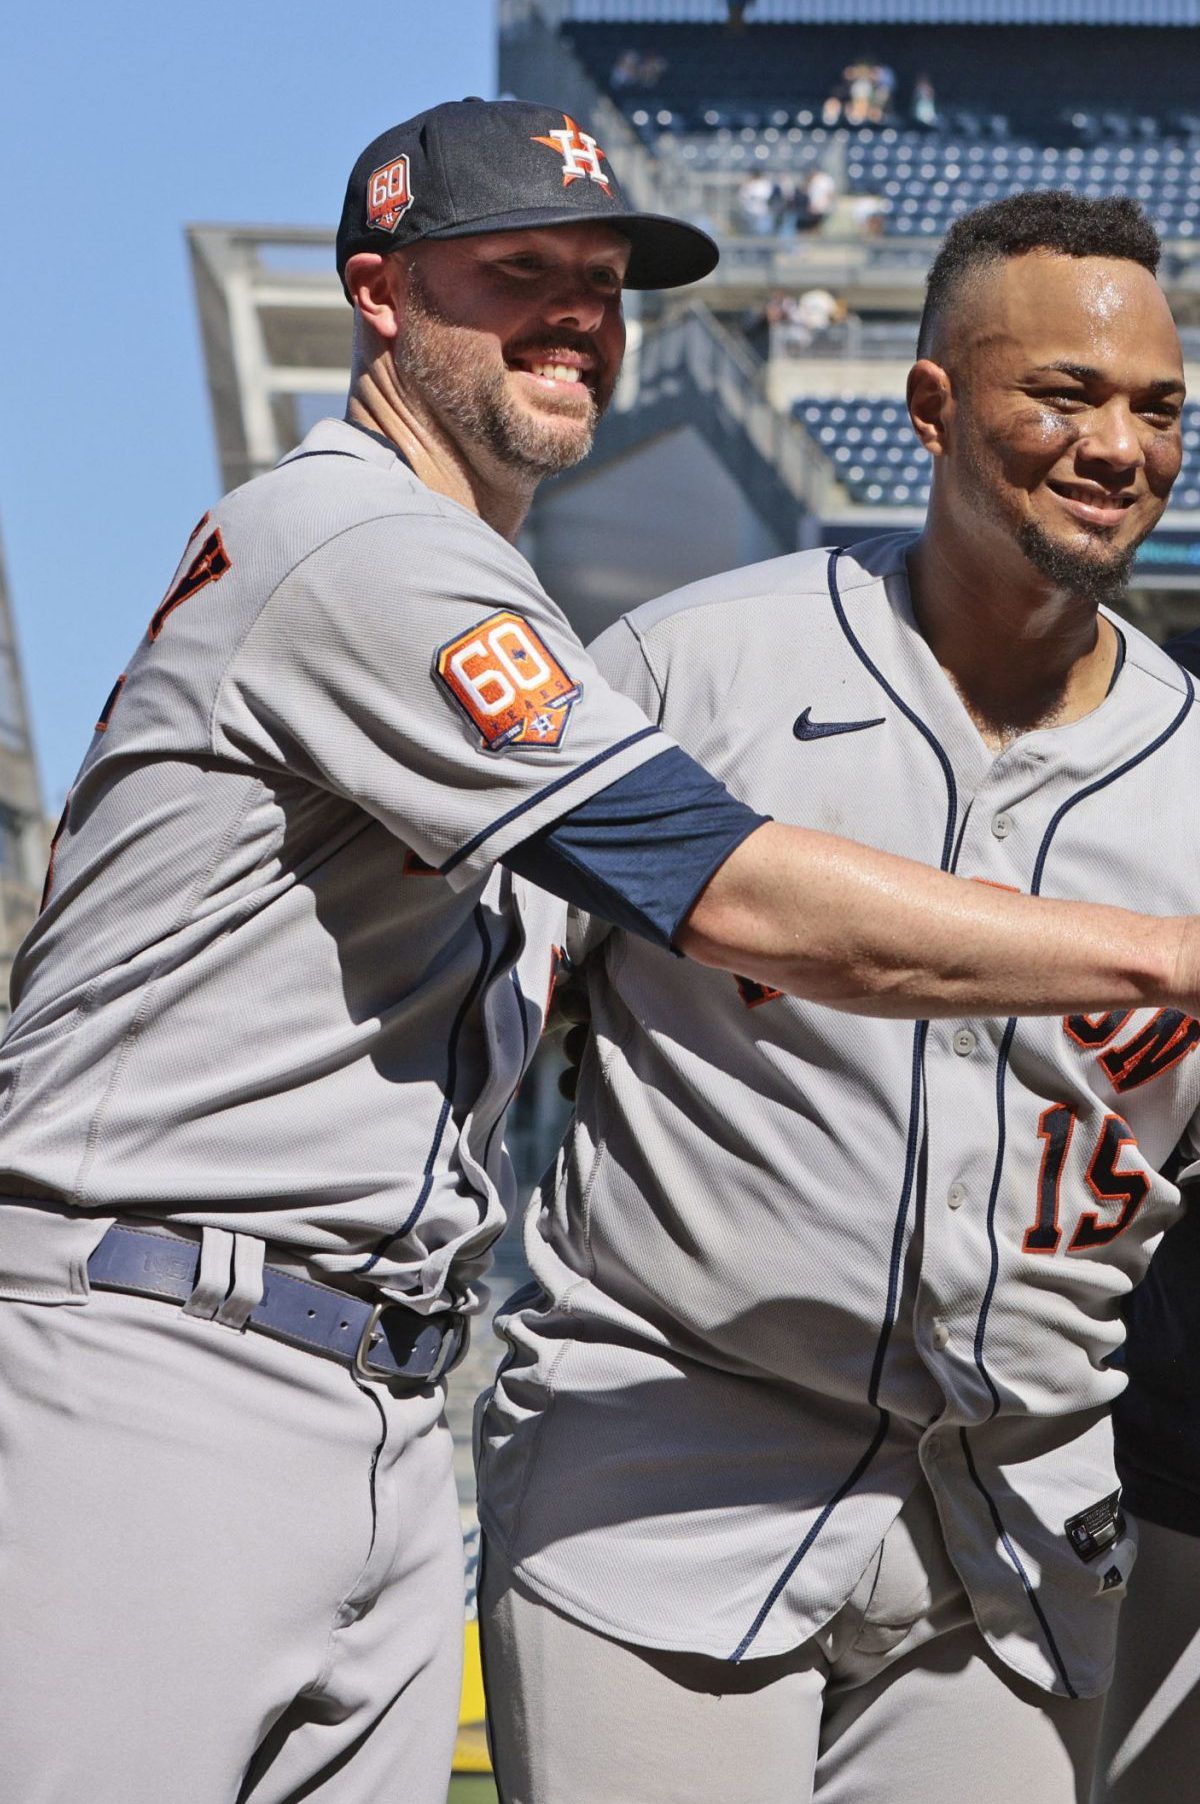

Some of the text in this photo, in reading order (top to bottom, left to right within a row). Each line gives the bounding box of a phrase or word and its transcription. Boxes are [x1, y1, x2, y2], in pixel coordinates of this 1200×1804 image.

[372, 162, 404, 207] 60
[549, 129, 609, 184] H
[451, 623, 551, 717] 60
[1022, 1102, 1150, 1253] 15
